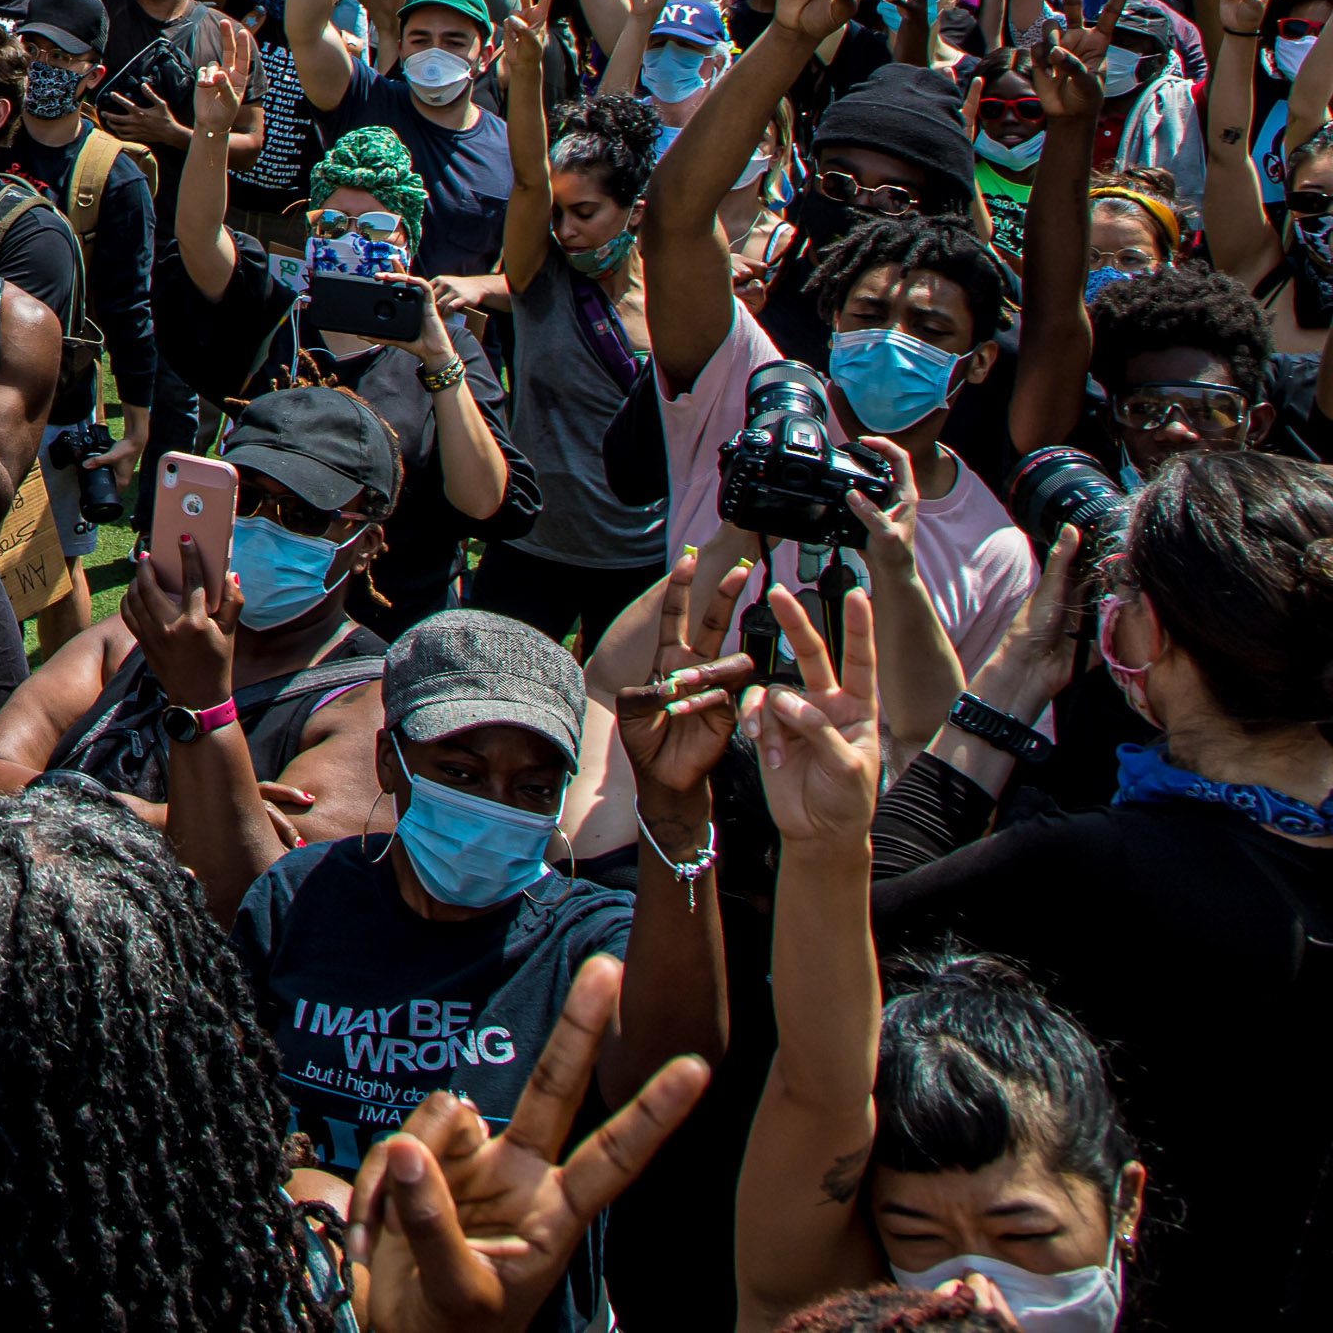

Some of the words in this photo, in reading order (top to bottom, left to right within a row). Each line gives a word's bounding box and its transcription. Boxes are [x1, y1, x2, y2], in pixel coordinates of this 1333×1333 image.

[656, 3, 701, 26] NY
[261, 41, 271, 53] I
[268, 86, 304, 101] Garner
[274, 96, 295, 107] Bell
[272, 105, 295, 115] Rice
[267, 136, 296, 147] Jones
[265, 143, 302, 155] Francis
[260, 150, 288, 162] Jones
[256, 157, 301, 170] Ferguson
[265, 166, 298, 177] Ferrell
[293, 998, 308, 1029] I
[309, 1003, 405, 1037] MAY
[409, 999, 472, 1038] BE
[343, 1025, 516, 1073] WRONG
[336, 1069, 343, 1087] i
[345, 1072, 401, 1104] highly
